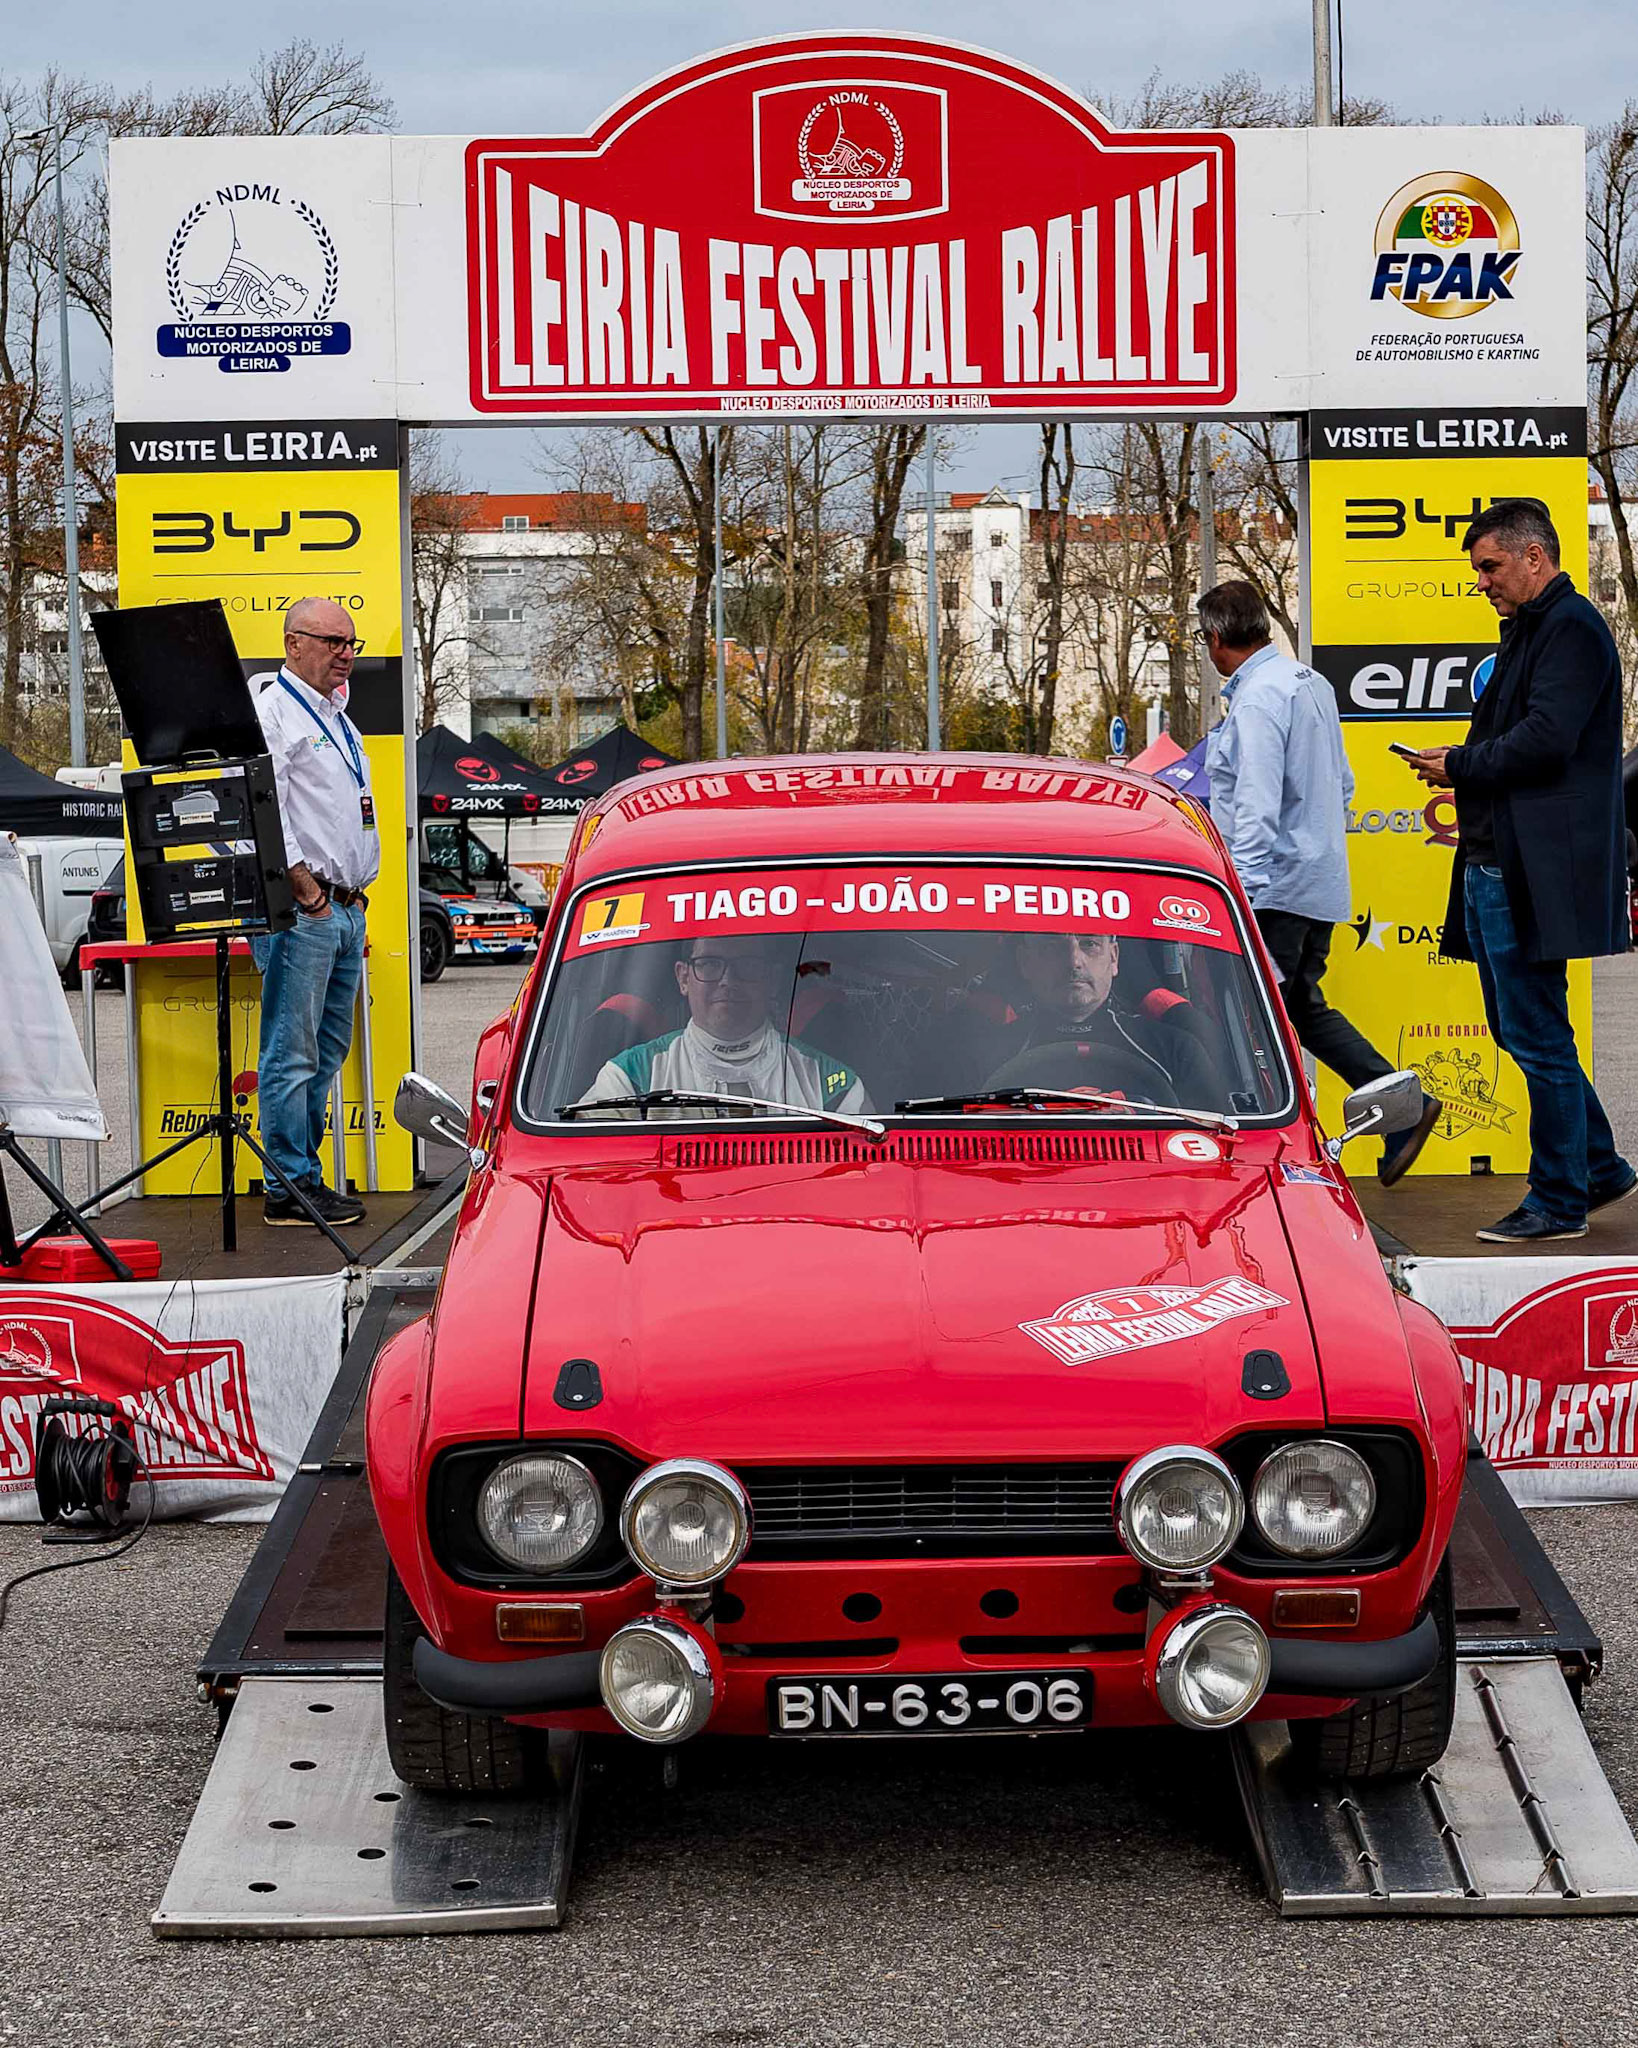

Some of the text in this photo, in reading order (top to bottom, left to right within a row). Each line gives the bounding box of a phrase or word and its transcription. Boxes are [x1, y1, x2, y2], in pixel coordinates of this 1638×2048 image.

[828, 91, 870, 107] NDML
[843, 181, 900, 189] DESPORTOS
[215, 183, 282, 206] NDML
[811, 191, 878, 199] MOTORIZADOS
[837, 201, 867, 209] LEIRIA
[495, 158, 1210, 388] LEIRIA FESTIVAL RALLYE
[1370, 252, 1524, 301] FPAK
[174, 324, 333, 338] NÚCLEO DESPORTOS
[1371, 332, 1524, 347] FEDERAÇÃO PORTUGUESA
[186, 341, 322, 355] MOTORIZADOS DE
[1356, 348, 1540, 361] DE AUTOMOBILISMO E KARTING
[230, 357, 280, 370] LEIRIA
[772, 396, 842, 410] DESPORTOS
[845, 396, 931, 409] MOTORIZADOS
[936, 396, 950, 409] DE
[952, 395, 991, 408] LEIRIA
[1323, 427, 1410, 449] VISITE
[129, 439, 217, 463] VISITE
[152, 510, 362, 554] BYD
[1350, 657, 1468, 710] elf
[62, 802, 105, 818] HISTORIC
[451, 797, 505, 811] 24MX
[62, 866, 100, 878] ANTUNES
[667, 885, 798, 923] TIAGO
[831, 876, 949, 914] JOÃO
[984, 884, 1130, 920] PEDRO
[604, 898, 620, 929] 7
[1409, 1023, 1441, 1037] JOÃO
[1443, 1100, 1487, 1123] ERVEJARIA
[1181, 1140, 1206, 1156] E
[1118, 1298, 1144, 1312] 7
[3, 1322, 28, 1331] NDML
[1041, 1281, 1273, 1357] LEIRIA FESTIVAL RALLYE
[1578, 1461, 1618, 1470] DESPORTOS
[778, 1679, 1084, 1729] BN-63-06
